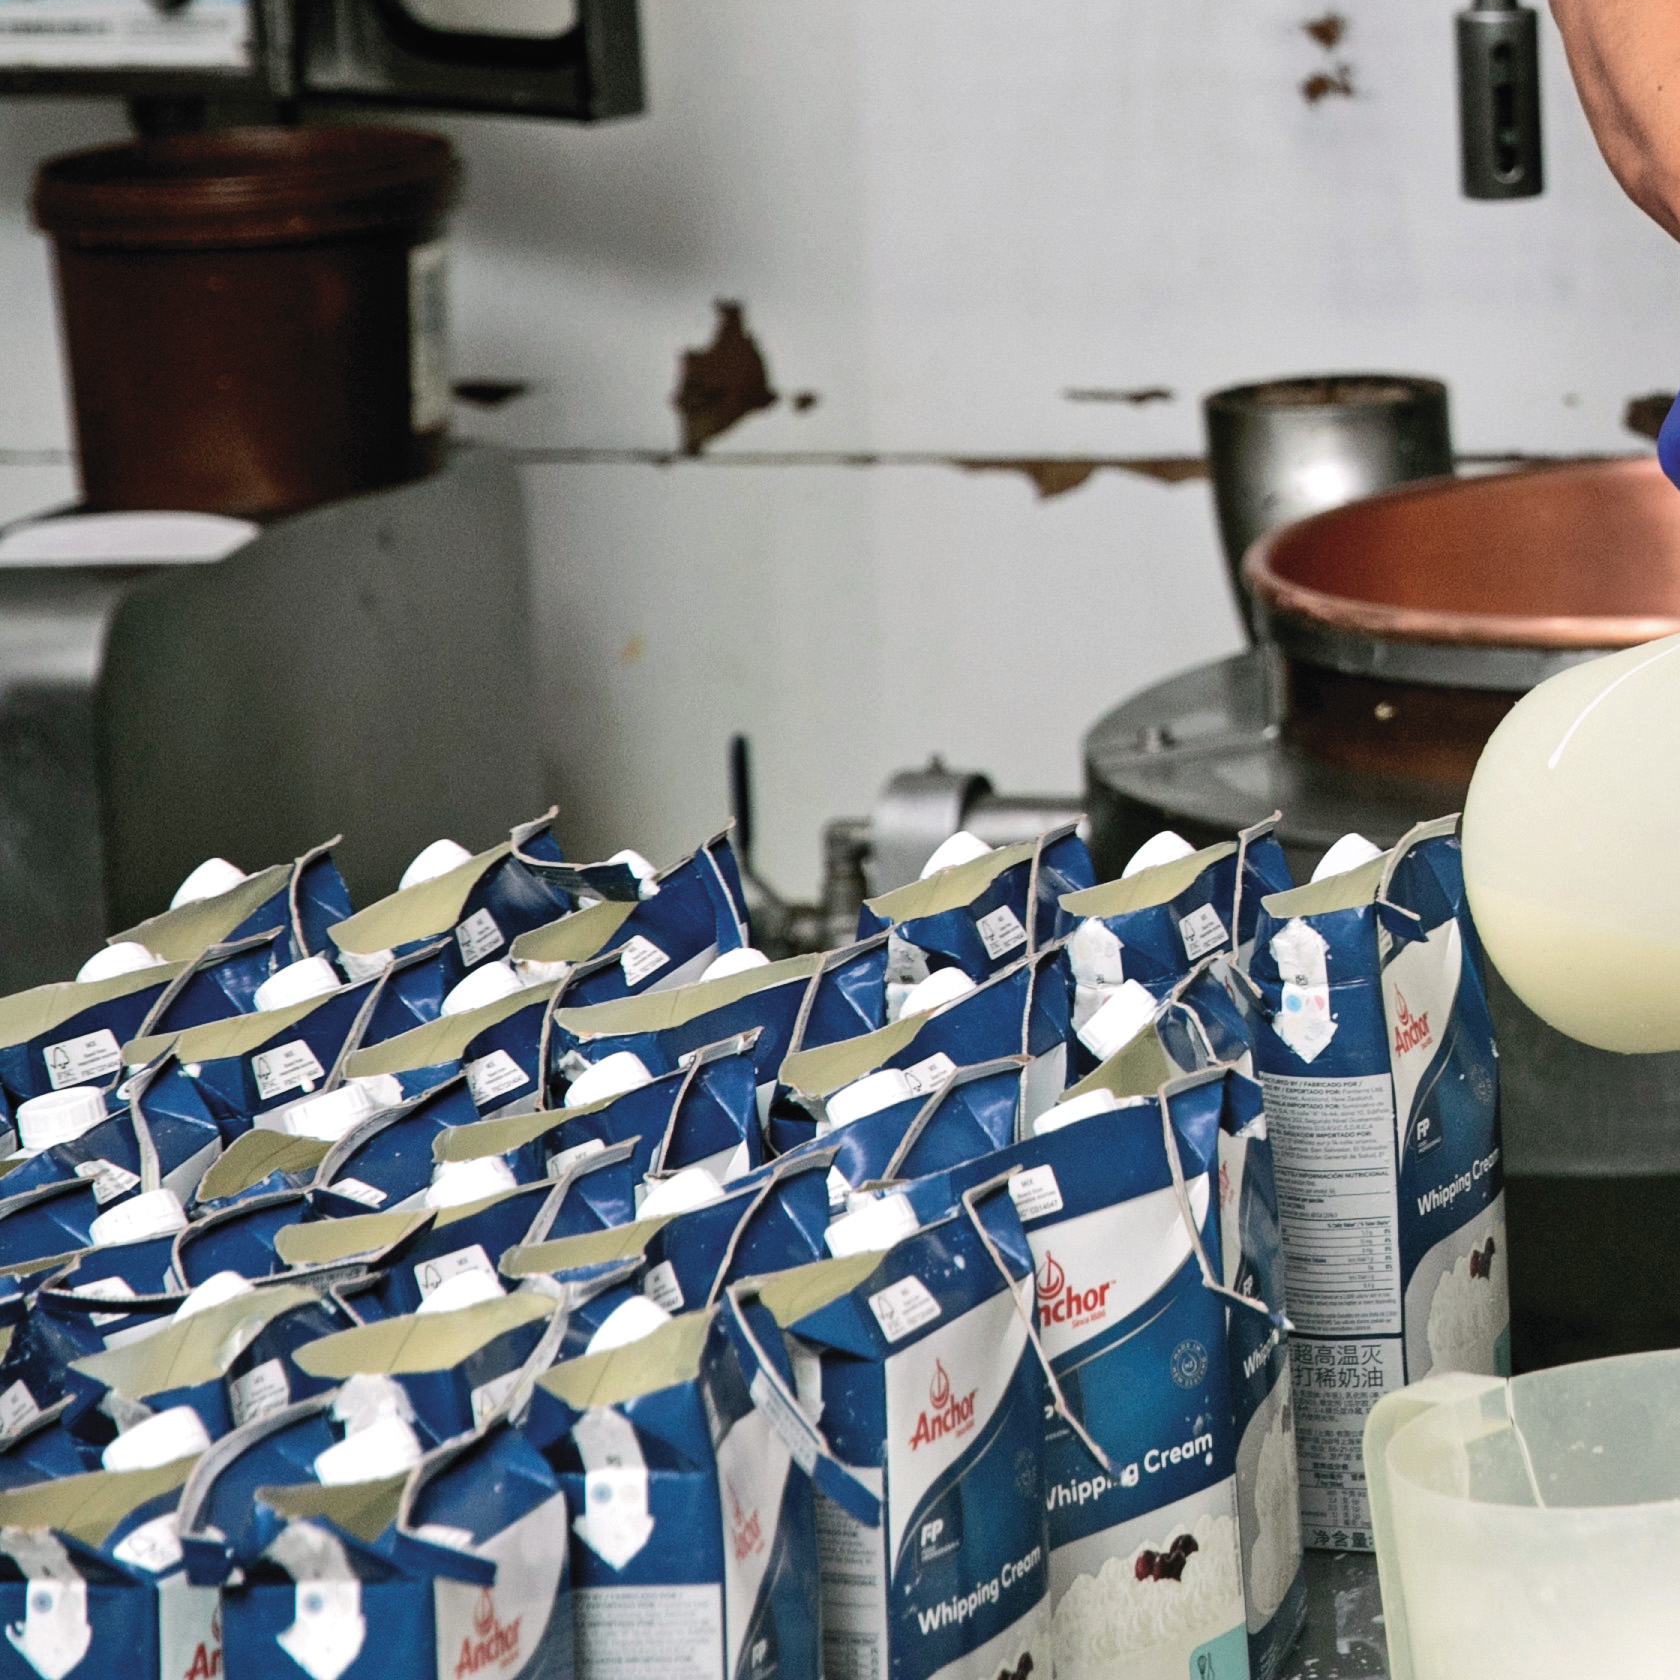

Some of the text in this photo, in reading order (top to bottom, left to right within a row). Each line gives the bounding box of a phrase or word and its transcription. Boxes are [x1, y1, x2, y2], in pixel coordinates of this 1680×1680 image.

[1395, 1012, 1430, 1057] Anchor
[1417, 1171, 1471, 1216] Whipping
[1038, 1281, 1110, 1327] nchor
[1288, 1343, 1383, 1366] 超高温灭
[1290, 1366, 1383, 1388] 打稀奶油
[909, 1390, 976, 1452] Anchor
[1144, 1433, 1213, 1473] Cream
[921, 1519, 943, 1547] FP
[918, 1578, 1000, 1635] Whipping
[1001, 1546, 1041, 1588] Cream
[454, 1616, 522, 1680] Anchor
